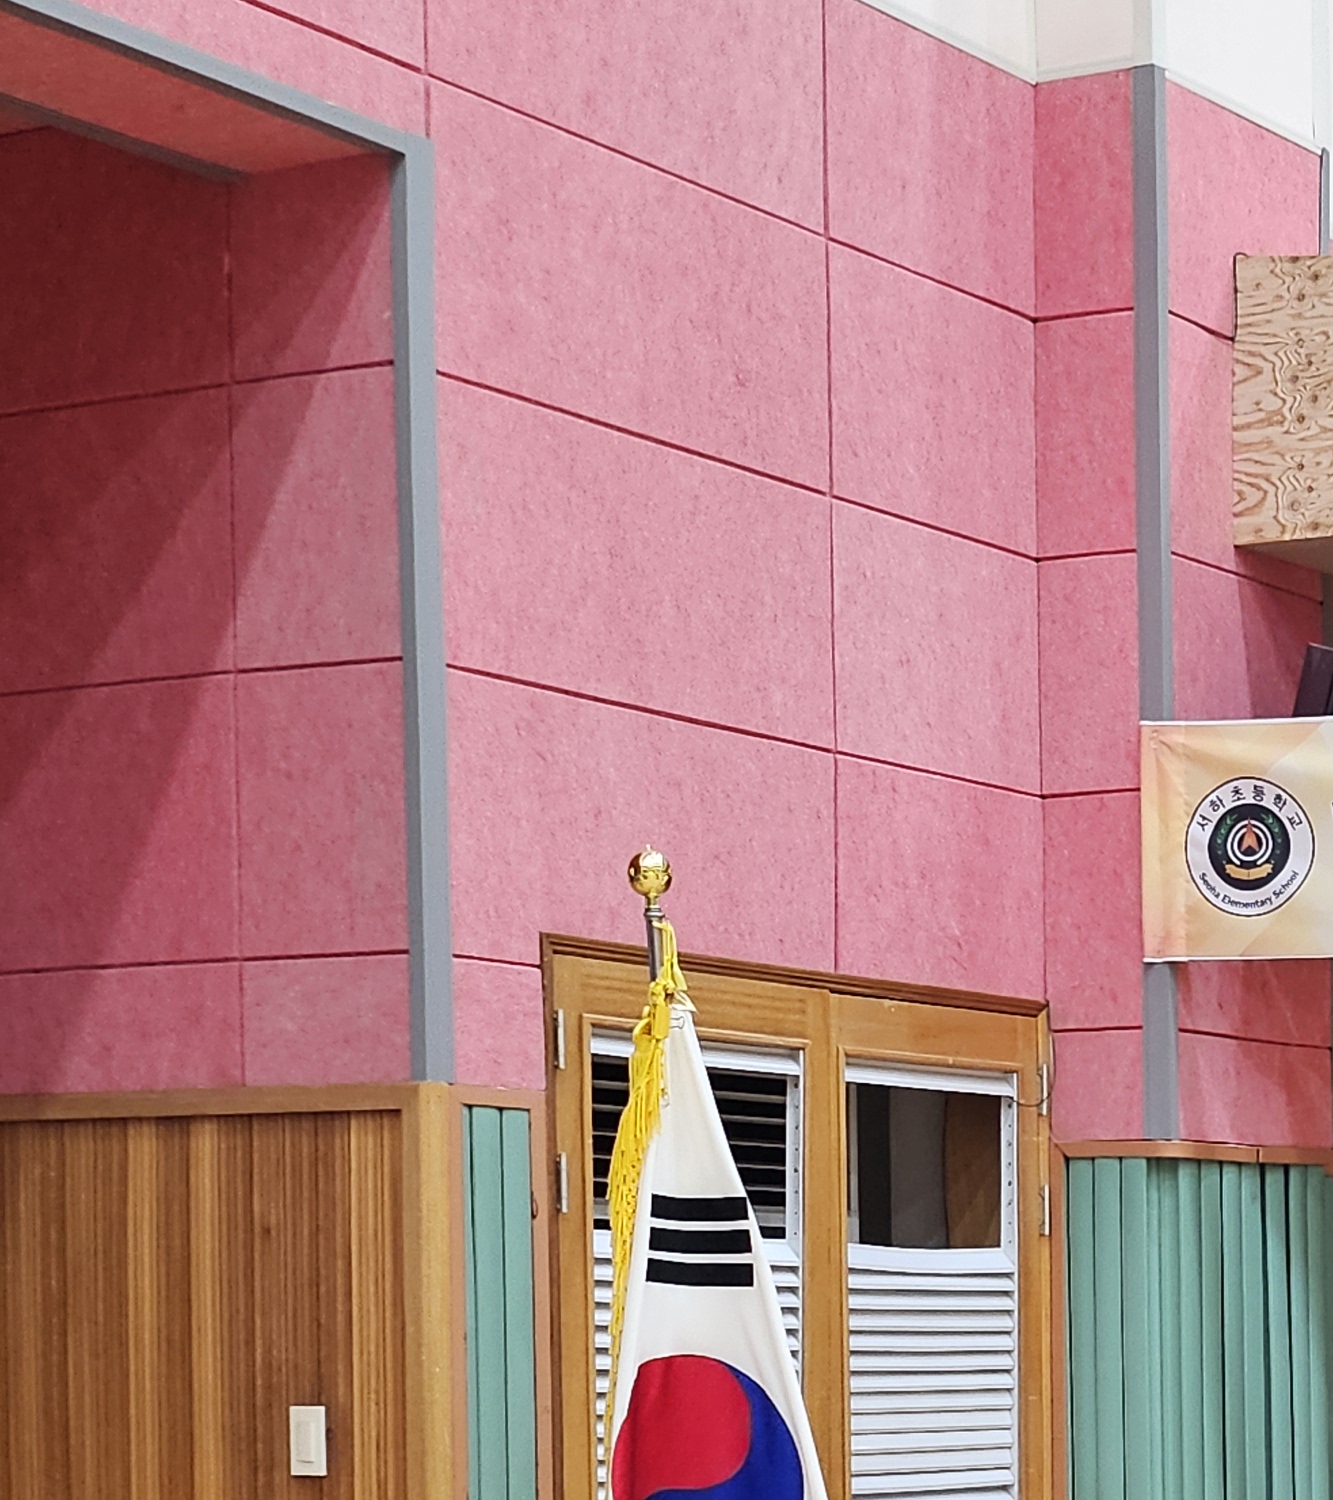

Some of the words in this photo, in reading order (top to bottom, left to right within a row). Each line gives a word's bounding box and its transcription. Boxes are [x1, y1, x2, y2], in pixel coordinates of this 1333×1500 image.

[1196, 784, 1304, 832] 서하초등학교
[1199, 872, 1221, 899] Seoha
[1221, 893, 1274, 910] Elementary
[1272, 869, 1300, 899] School
